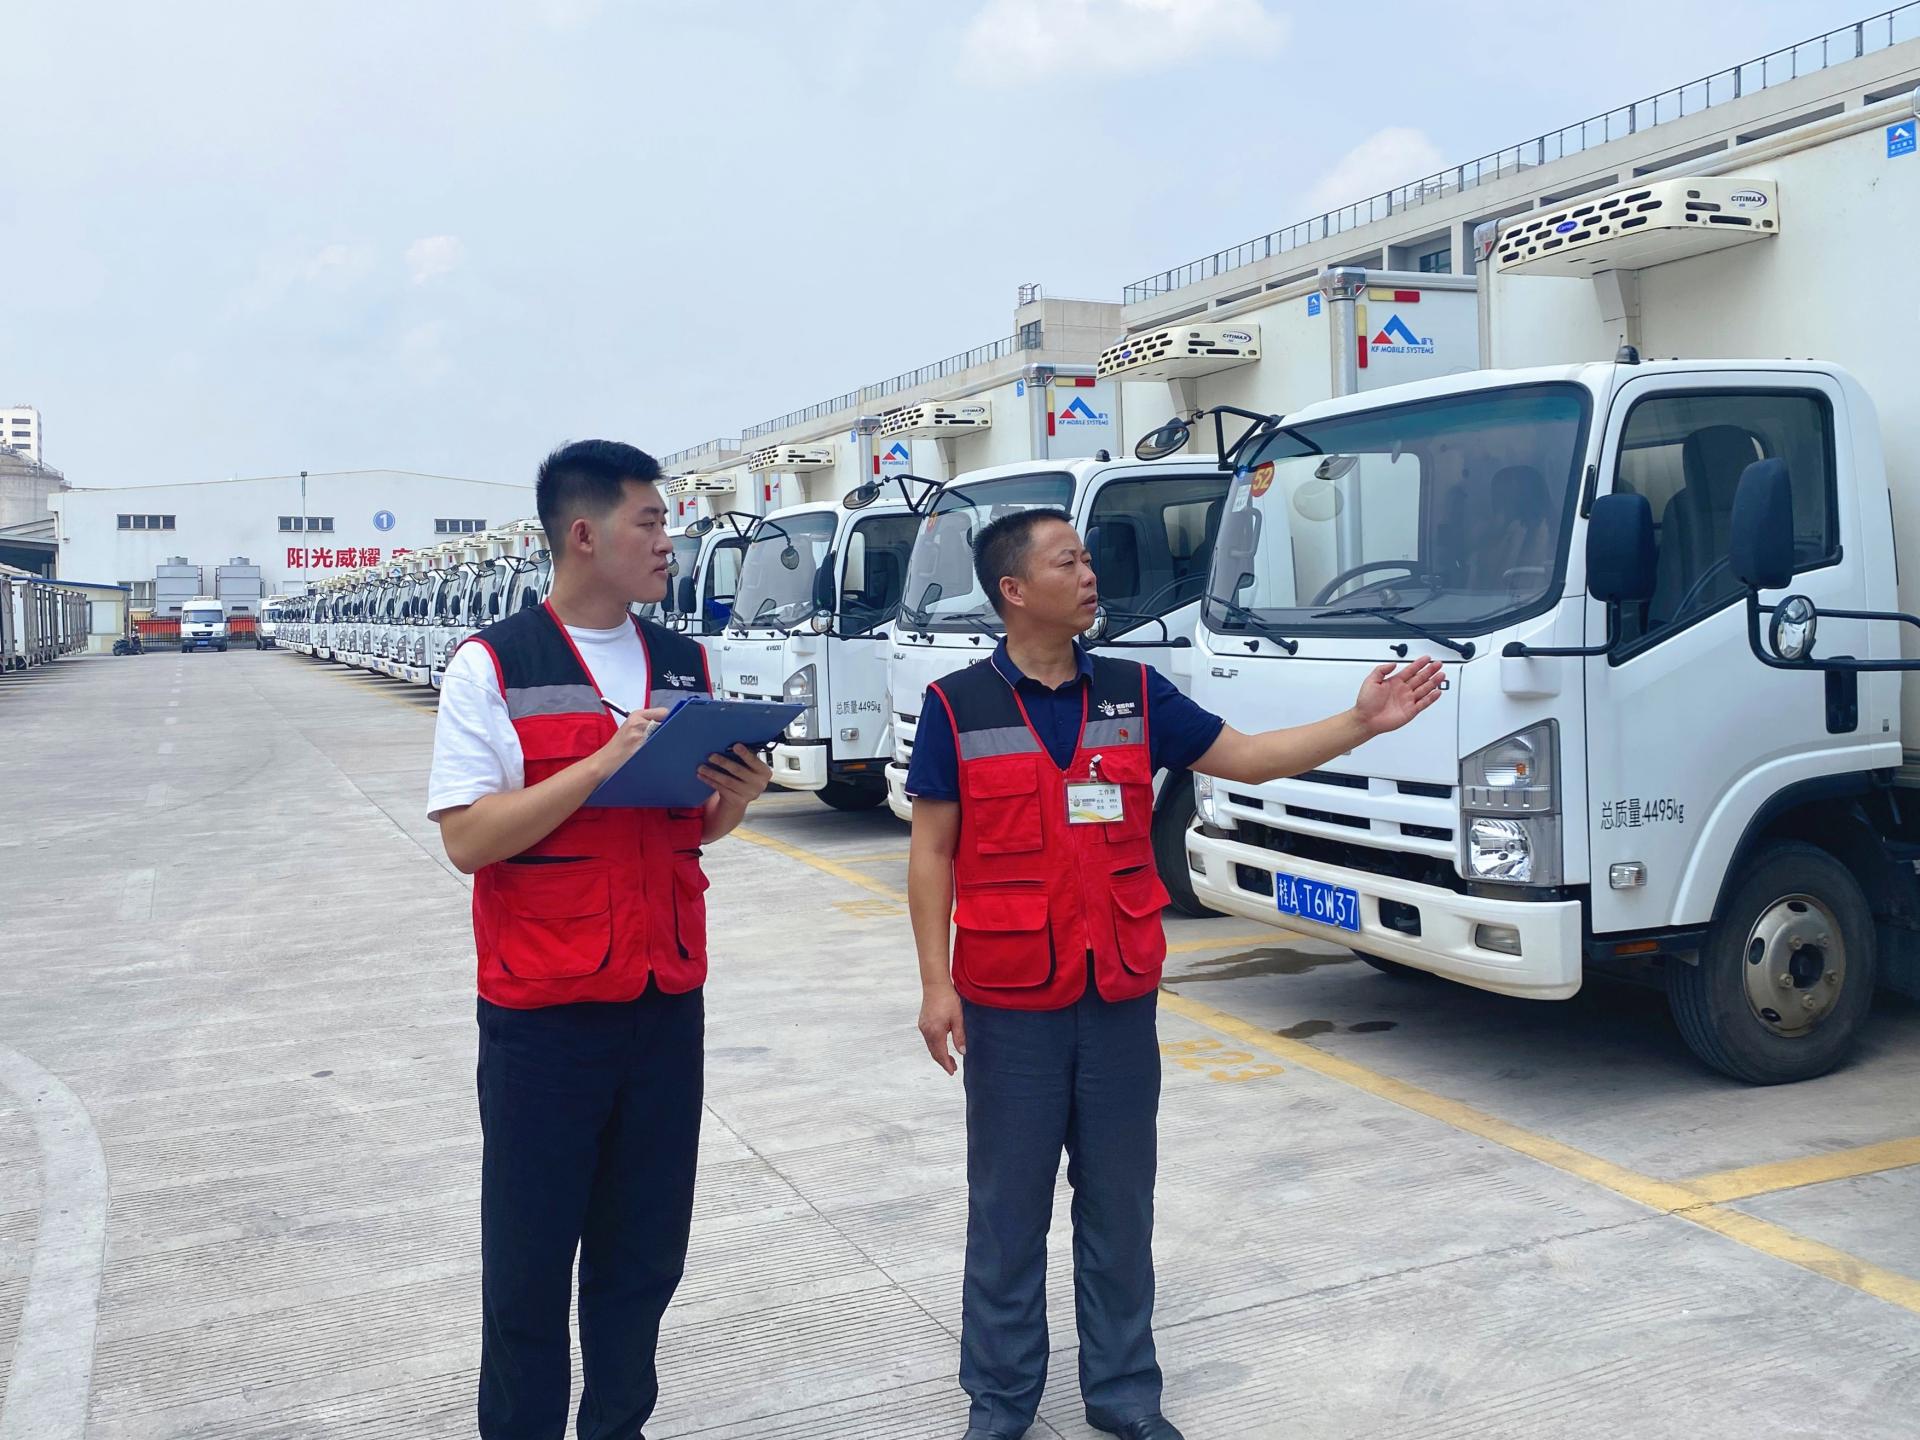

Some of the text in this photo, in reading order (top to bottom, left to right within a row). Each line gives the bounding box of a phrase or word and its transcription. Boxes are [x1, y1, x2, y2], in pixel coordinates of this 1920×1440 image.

[1381, 346, 1405, 354] MOBILE
[1407, 346, 1434, 354] SYSTEMS
[1253, 467, 1273, 491] 52
[287, 547, 381, 569] 阳光威耀
